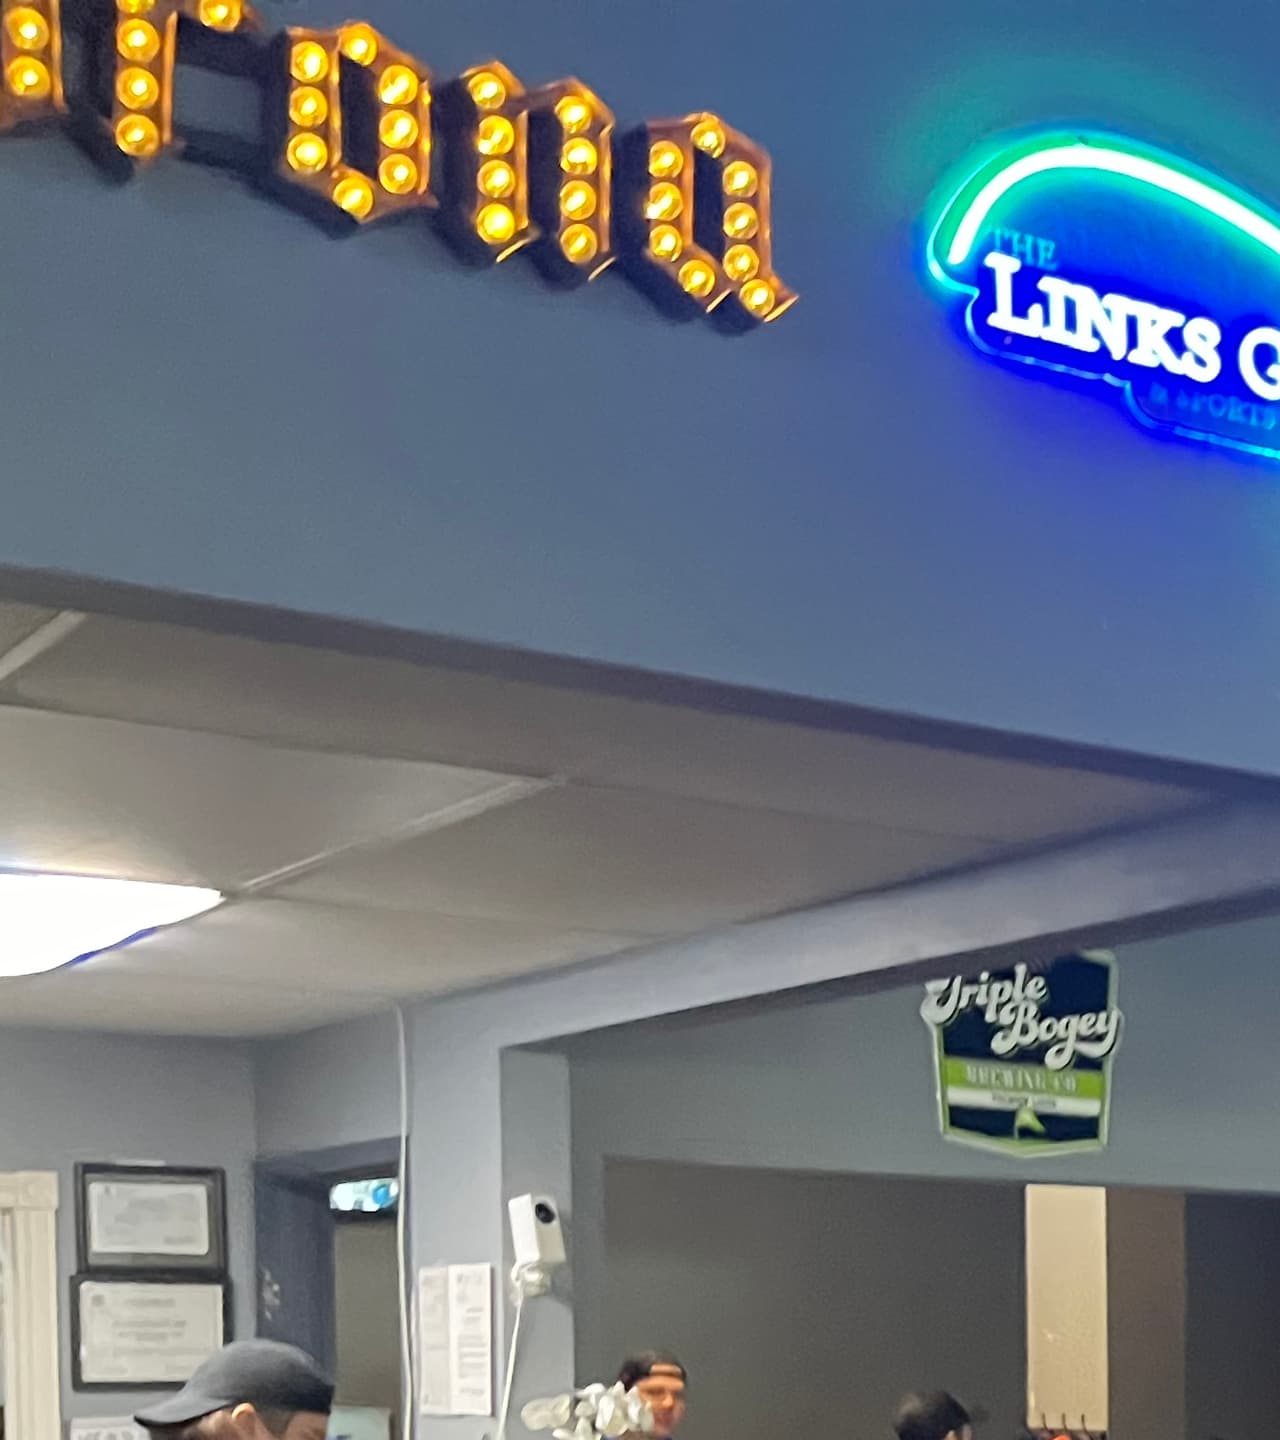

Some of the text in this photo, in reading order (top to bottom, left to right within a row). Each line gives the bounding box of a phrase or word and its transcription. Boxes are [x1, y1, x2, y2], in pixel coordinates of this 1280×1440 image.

[985, 228, 1057, 271] THE
[983, 250, 1222, 383] LINKS
[920, 961, 1048, 1025] Triple
[990, 1000, 1119, 1070] Bogey
